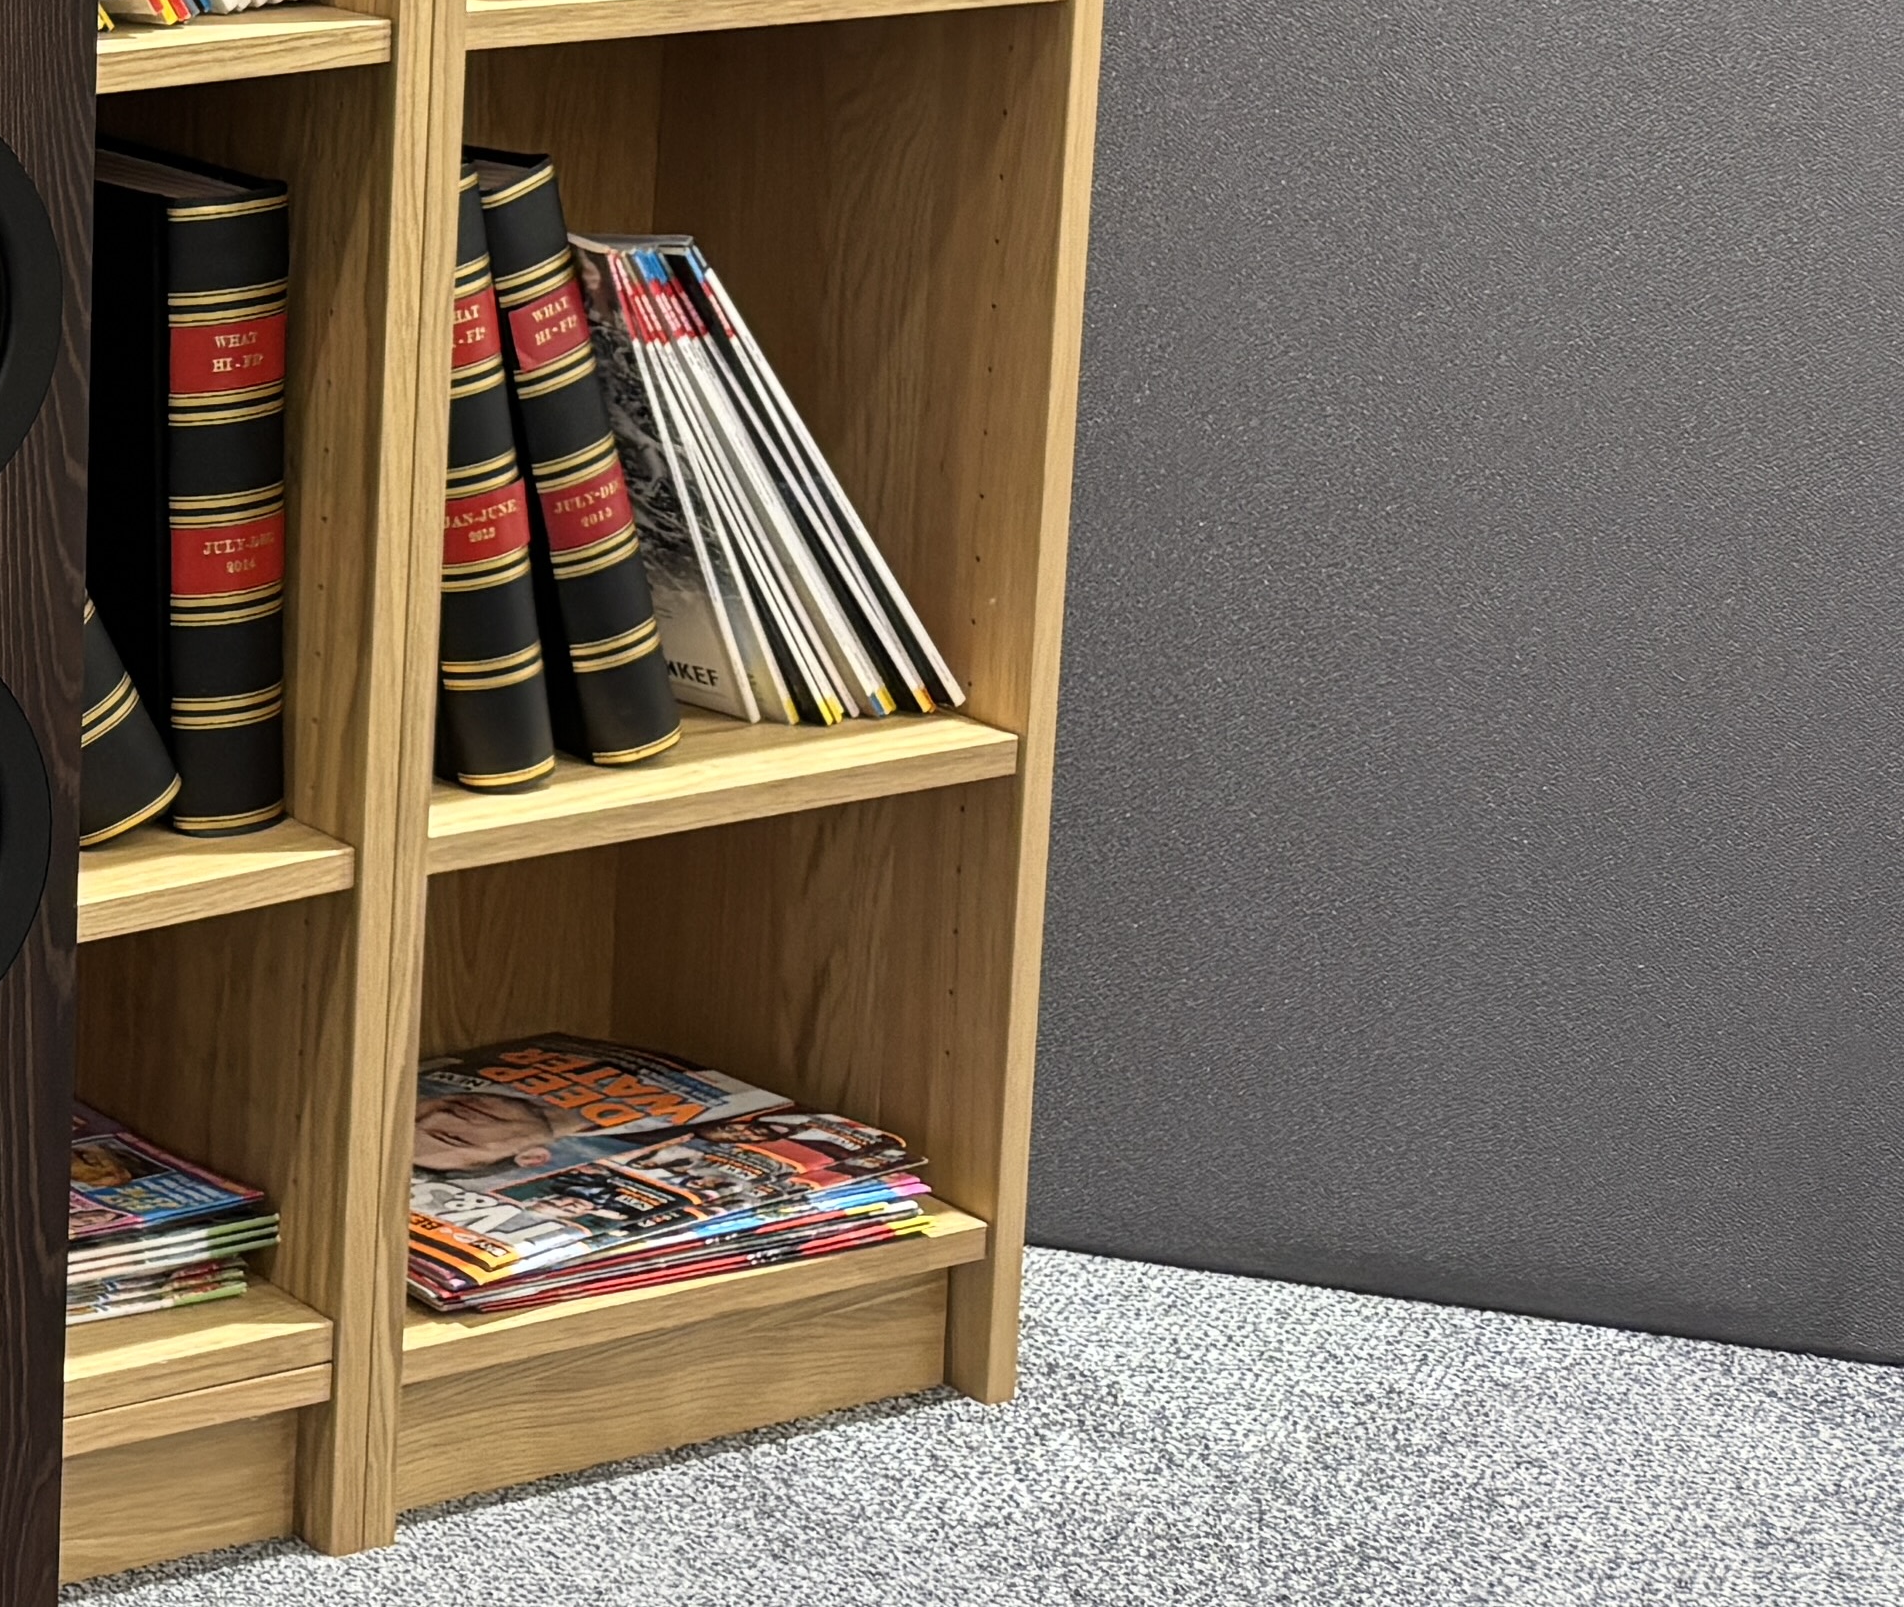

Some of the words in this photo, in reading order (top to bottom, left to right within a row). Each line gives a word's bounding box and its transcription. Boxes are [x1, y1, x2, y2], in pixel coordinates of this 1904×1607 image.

[531, 296, 569, 322] WHAT
[214, 332, 258, 349] WHAT
[478, 1065, 646, 1128] DEEP
[499, 1047, 708, 1126] WATER
